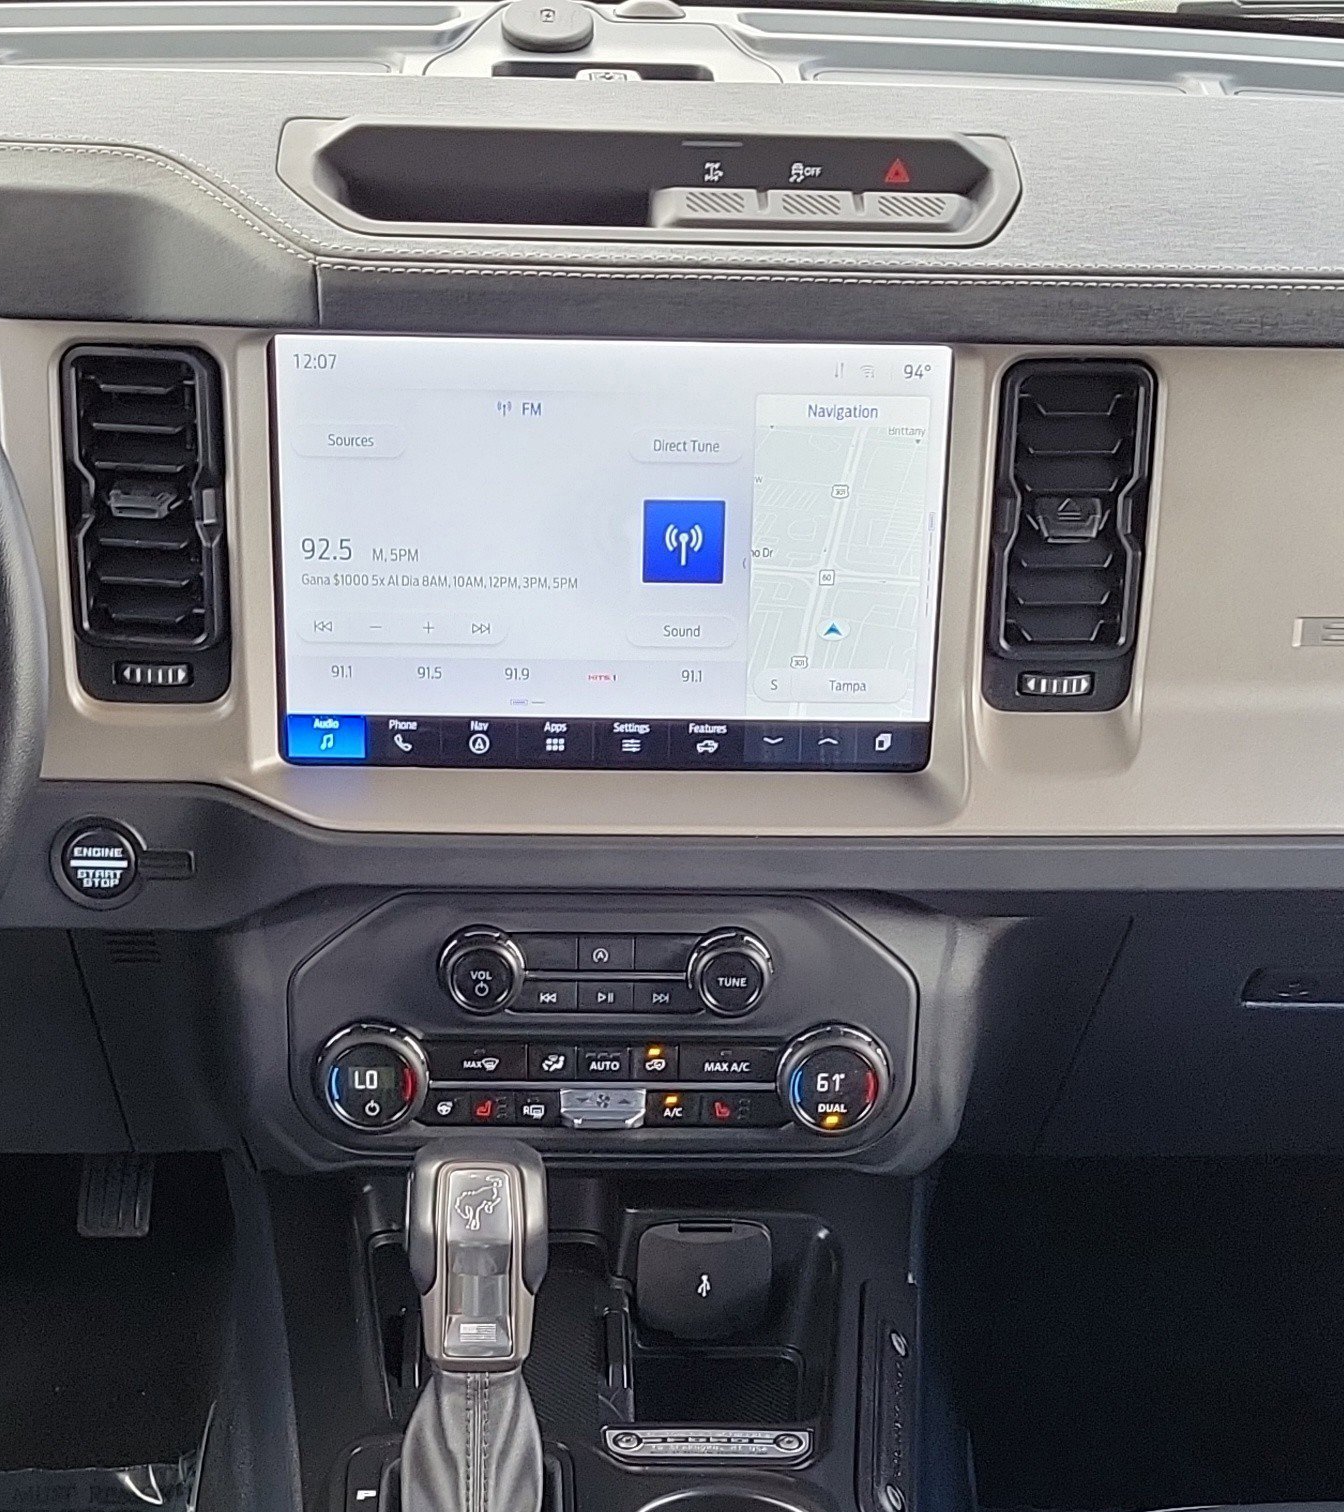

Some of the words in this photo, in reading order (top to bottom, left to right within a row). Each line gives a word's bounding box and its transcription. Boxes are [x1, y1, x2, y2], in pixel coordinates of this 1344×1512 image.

[804, 166, 823, 177] OFF
[293, 353, 337, 370] 12:07
[903, 364, 932, 379] 94°
[522, 402, 543, 416] FM
[807, 403, 879, 421] Navigation
[327, 433, 374, 448] Sources
[653, 439, 687, 453] Direct
[690, 440, 720, 453] Tune
[301, 538, 353, 561] 92.5
[390, 549, 419, 562] 5PM
[762, 547, 774, 559] Dr
[301, 573, 331, 587] Gana
[333, 573, 369, 587] $1000
[371, 575, 385, 587] 5x
[387, 574, 400, 587] Al
[401, 574, 420, 588] Dia
[422, 575, 451, 590] 8AM,
[453, 576, 487, 590] 10AM,
[488, 576, 521, 590] 12PM,
[522, 576, 551, 590] 3PM,
[553, 577, 578, 590] 5PM
[663, 625, 701, 639] Sound
[331, 665, 353, 678] 91.1
[417, 666, 442, 680] 91.5
[504, 667, 530, 681] 91.9
[681, 670, 703, 684] 91.1
[770, 680, 778, 691] S
[829, 680, 867, 694] Tampa
[313, 718, 340, 730] Audio
[388, 718, 417, 731] Phone
[470, 720, 490, 732] Nav
[544, 721, 568, 734] Apps
[612, 721, 651, 736] Settings
[688, 722, 728, 735] Features
[73, 846, 124, 858] ENGINE
[76, 869, 124, 879] START
[82, 878, 120, 888] STOP
[469, 969, 493, 981] VOL
[717, 977, 748, 988] TUNE
[463, 1059, 482, 1070] MAX
[589, 1060, 620, 1071] AUTO
[704, 1061, 729, 1072] MAX
[730, 1061, 751, 1073] A/C
[354, 1069, 379, 1090] LO
[663, 1107, 683, 1119] A/C
[817, 1103, 848, 1113] DUAL
[356, 1489, 377, 1500] P
